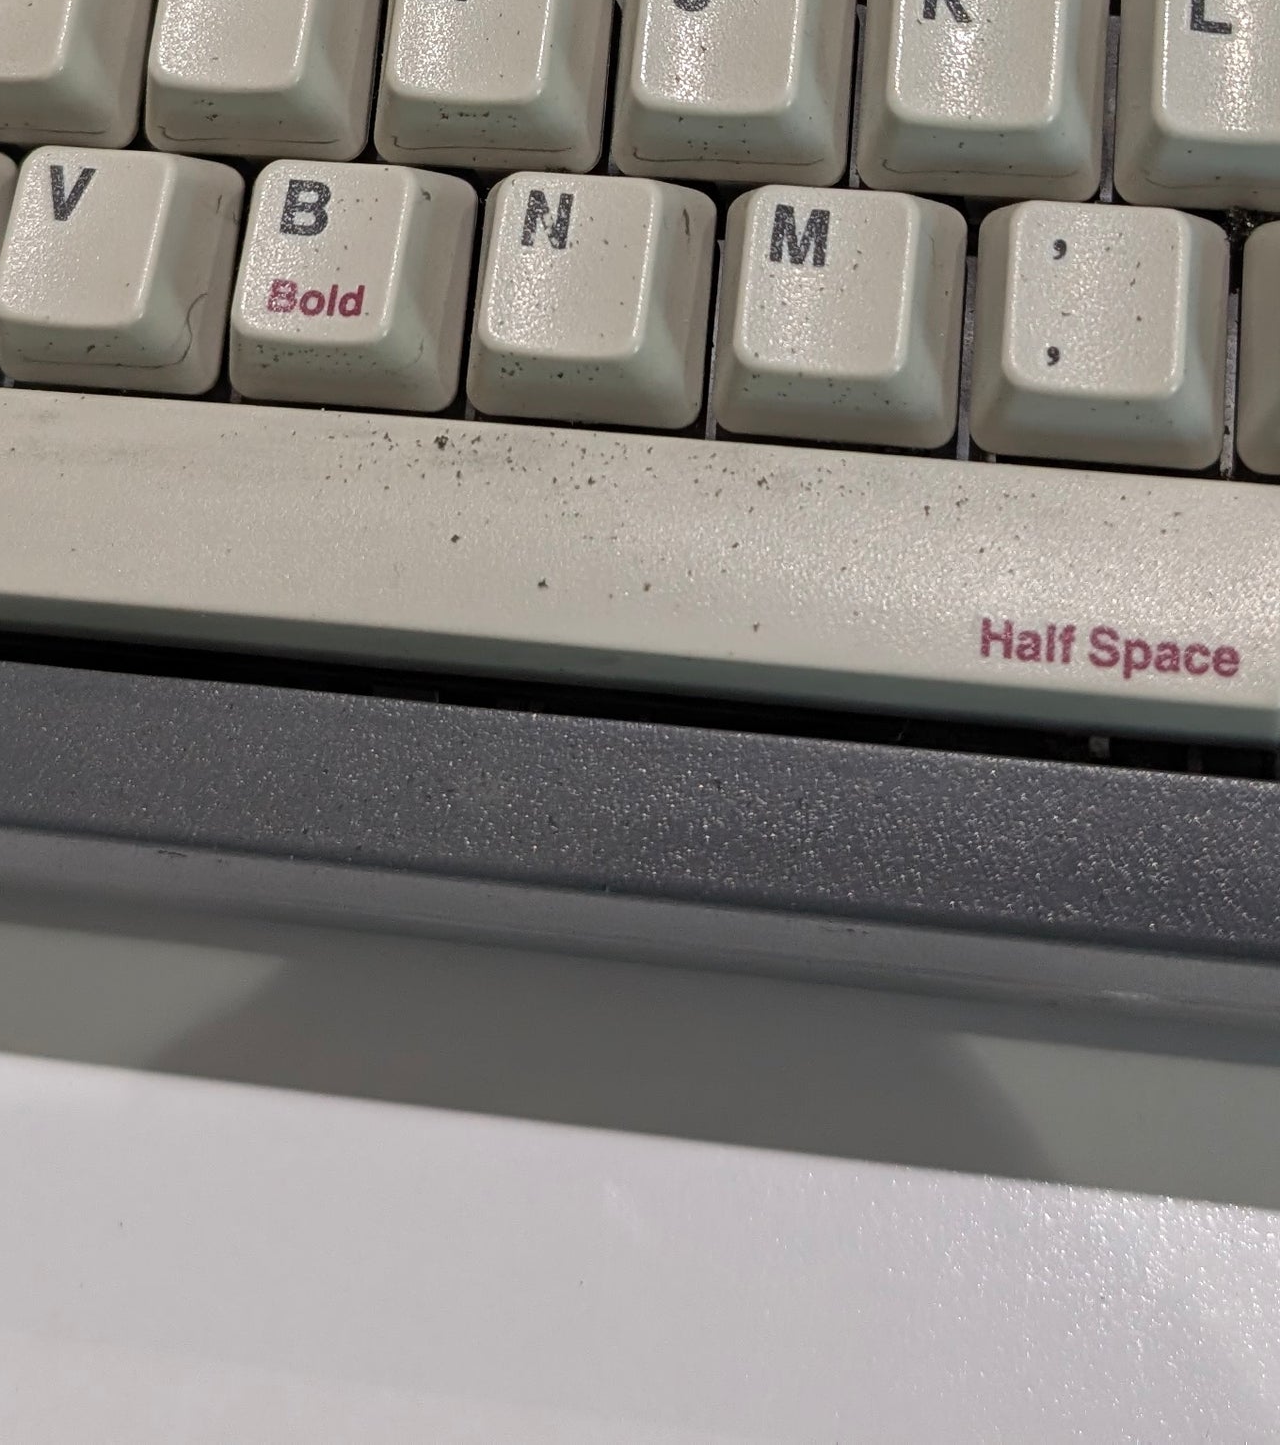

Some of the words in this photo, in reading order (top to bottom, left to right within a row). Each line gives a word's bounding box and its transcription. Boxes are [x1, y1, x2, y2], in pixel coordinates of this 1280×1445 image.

[49, 165, 96, 221] V
[279, 179, 332, 237] B
[520, 189, 574, 250] N
[769, 204, 831, 267] M
[267, 279, 365, 318] Bold
[980, 618, 1076, 664] Half
[1088, 626, 1240, 680] Space
